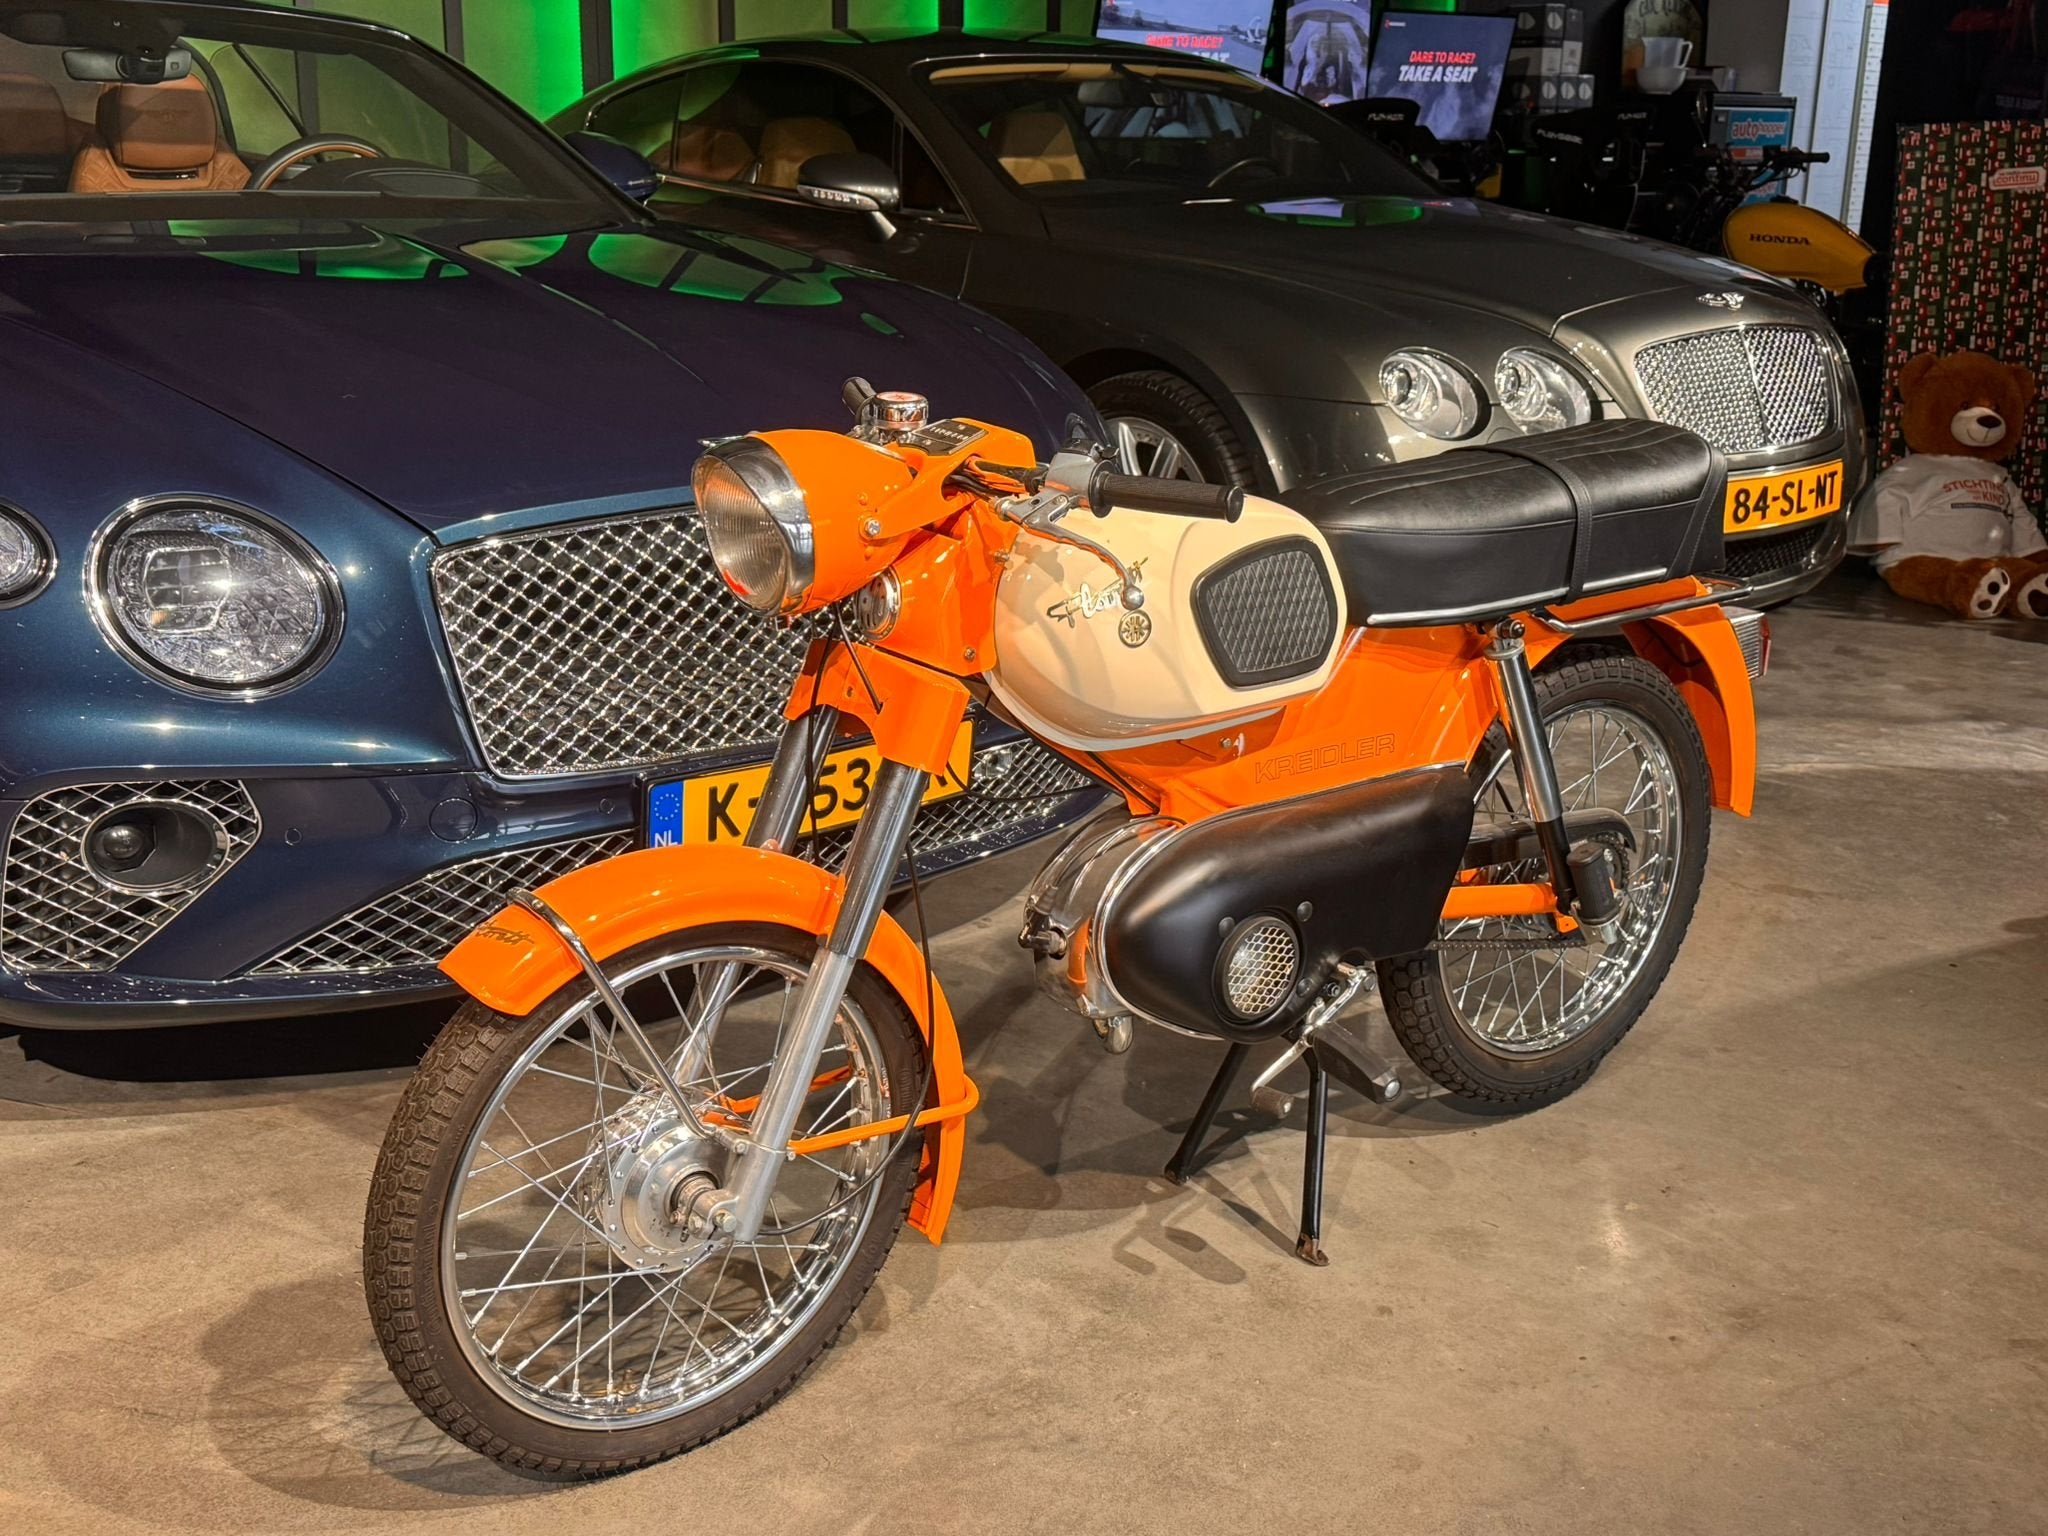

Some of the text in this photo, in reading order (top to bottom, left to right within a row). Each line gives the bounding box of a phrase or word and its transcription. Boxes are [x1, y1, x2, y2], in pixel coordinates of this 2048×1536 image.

[1409, 50, 1477, 64] DARE TO RACE?
[1398, 65, 1478, 82] TAKE A SEAT
[1749, 232, 1811, 246] HONDA
[1732, 470, 1839, 524] 84-SL-NT
[1254, 733, 1395, 784] KREIDLER
[654, 829, 678, 848] NL
